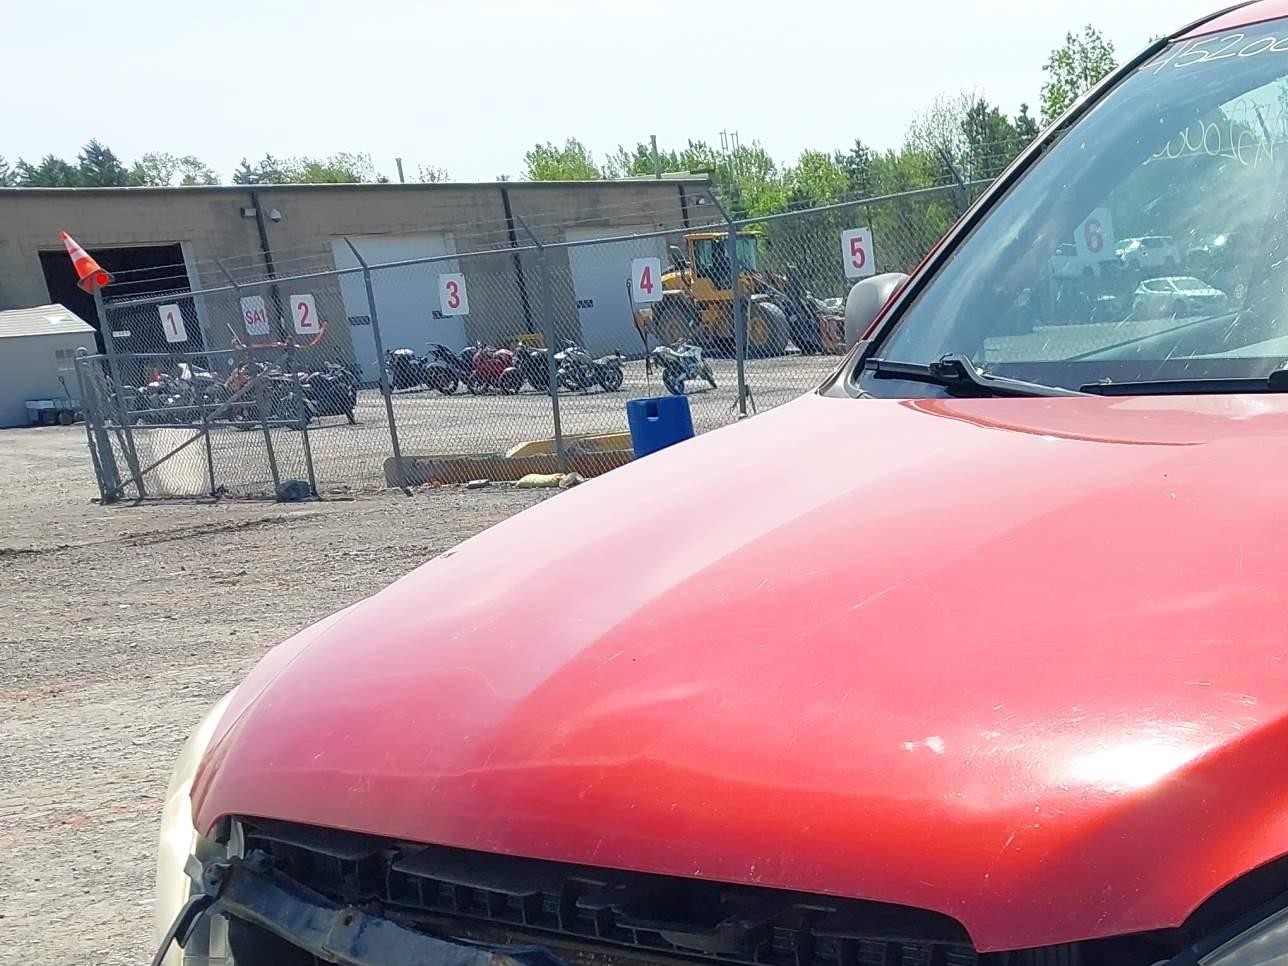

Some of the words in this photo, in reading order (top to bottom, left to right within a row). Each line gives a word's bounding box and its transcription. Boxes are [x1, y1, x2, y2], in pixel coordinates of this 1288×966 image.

[1084, 218, 1104, 253] 6
[849, 236, 866, 269] 5
[638, 265, 654, 294] 4
[446, 281, 460, 309] 3
[166, 311, 178, 336] 1
[297, 302, 312, 328] 2
